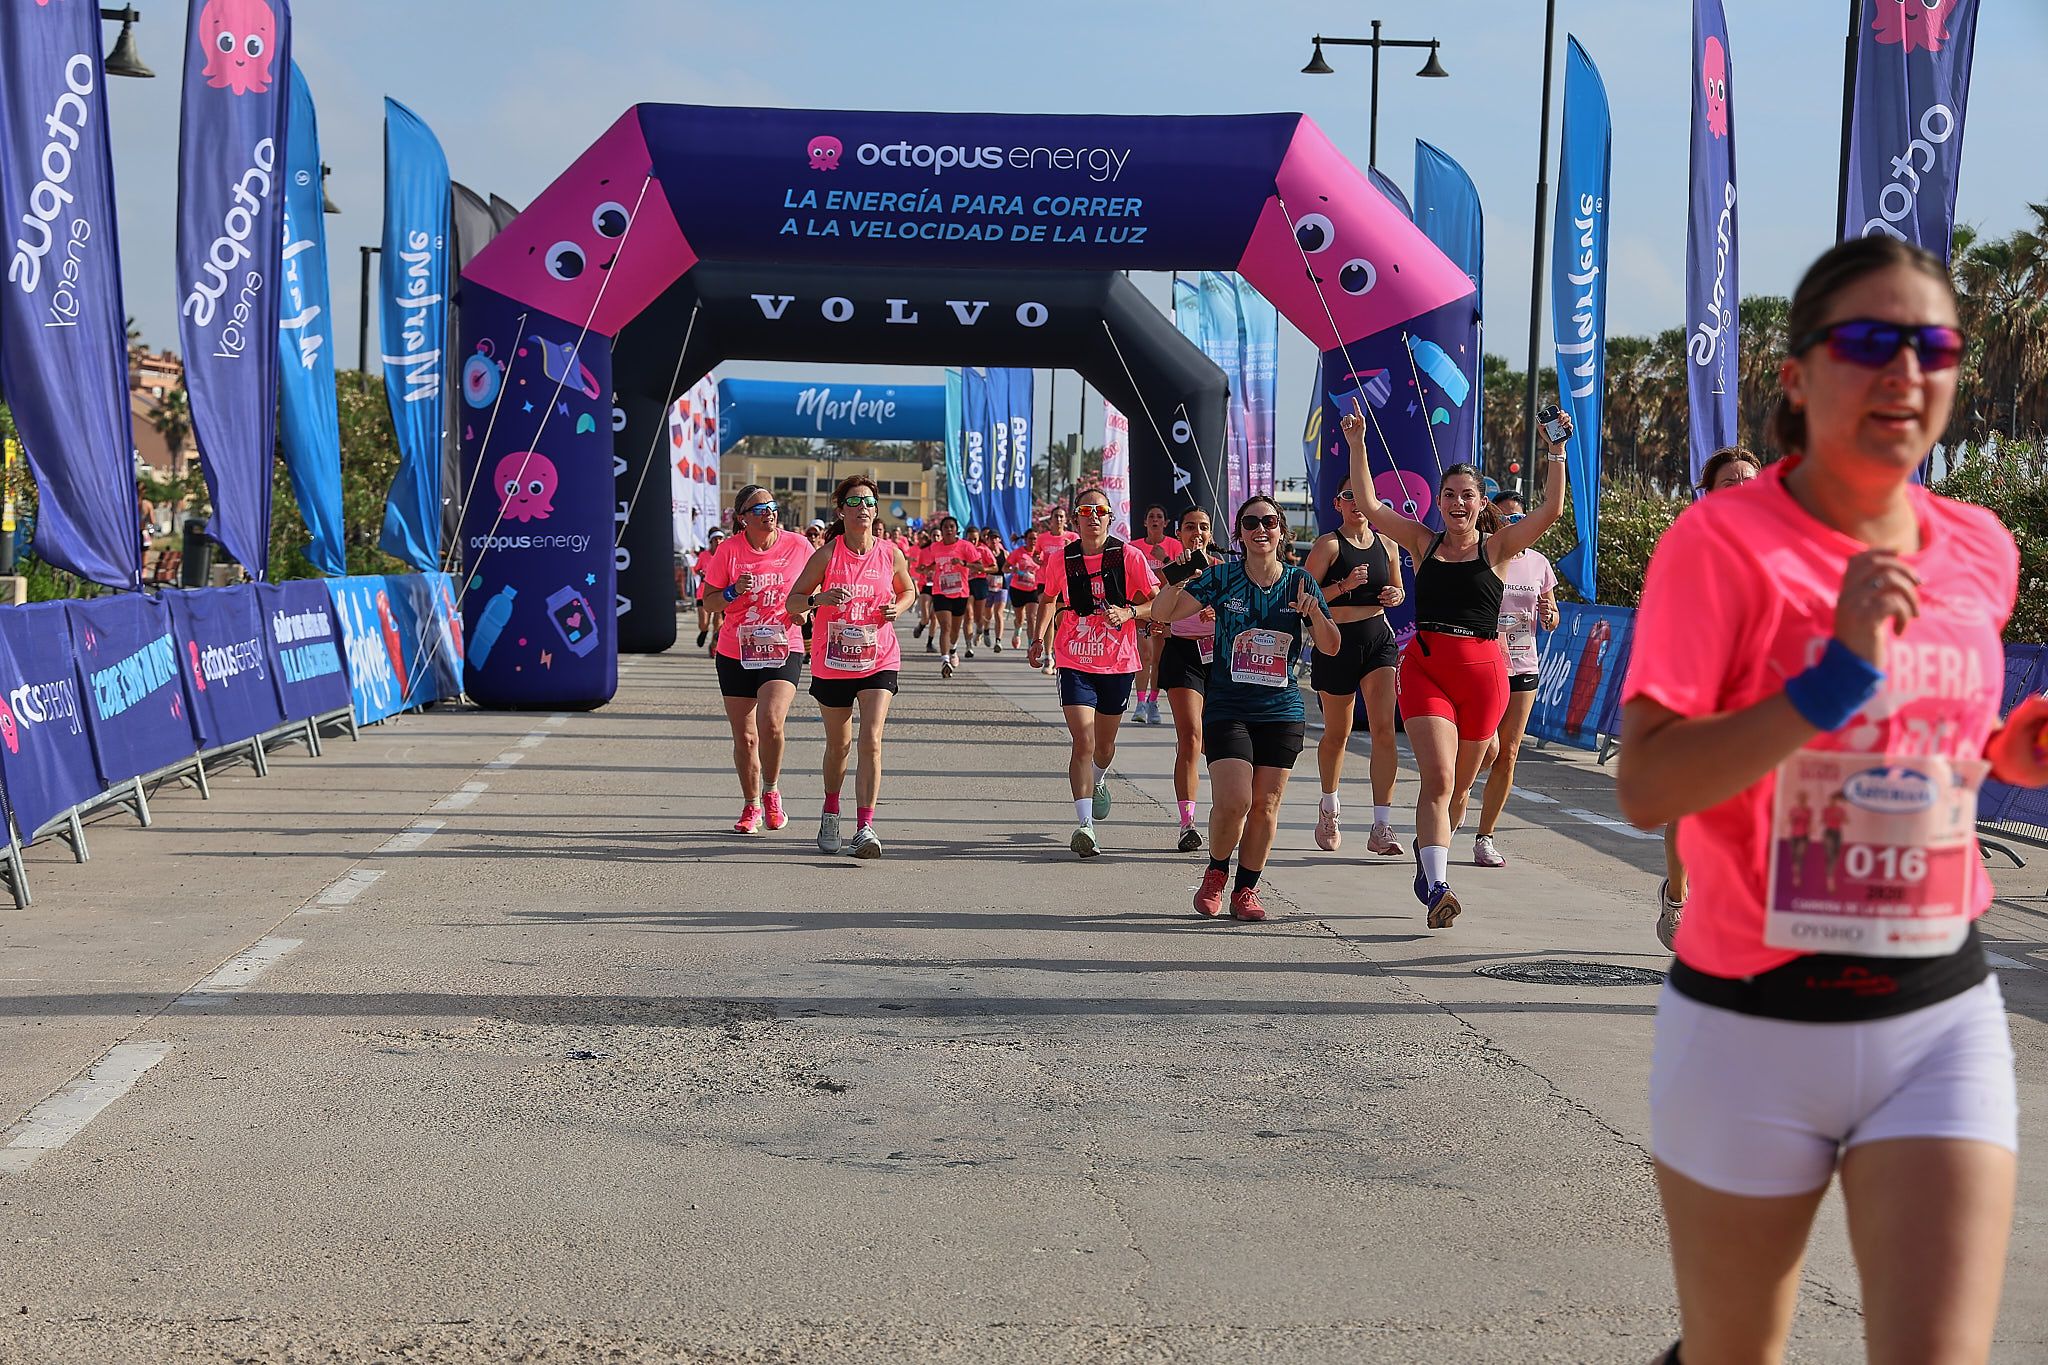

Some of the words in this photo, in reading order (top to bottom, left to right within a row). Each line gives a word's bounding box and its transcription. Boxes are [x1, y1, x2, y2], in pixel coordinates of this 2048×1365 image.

[856, 140, 1003, 175] octopus
[1008, 146, 1131, 182] energy
[783, 188, 817, 210] LA
[825, 188, 944, 215] ENERGÍA
[951, 194, 1024, 216] PARA
[1032, 196, 1142, 217] CORRER
[779, 218, 799, 236] A
[806, 219, 840, 237] LA
[849, 220, 1004, 242] VELOCIDAD
[1010, 225, 1047, 242] DE
[1052, 226, 1087, 243] LA
[1094, 226, 1148, 244] LUZ
[751, 293, 1049, 328] VOLVO
[796, 387, 896, 431] Marlene
[470, 533, 531, 552] octopus
[532, 534, 591, 552] energy
[755, 644, 774, 654] 016
[842, 645, 863, 654] 016
[1069, 640, 1105, 656] MUJER
[1251, 653, 1274, 665] 016
[1845, 844, 1928, 882] 016
